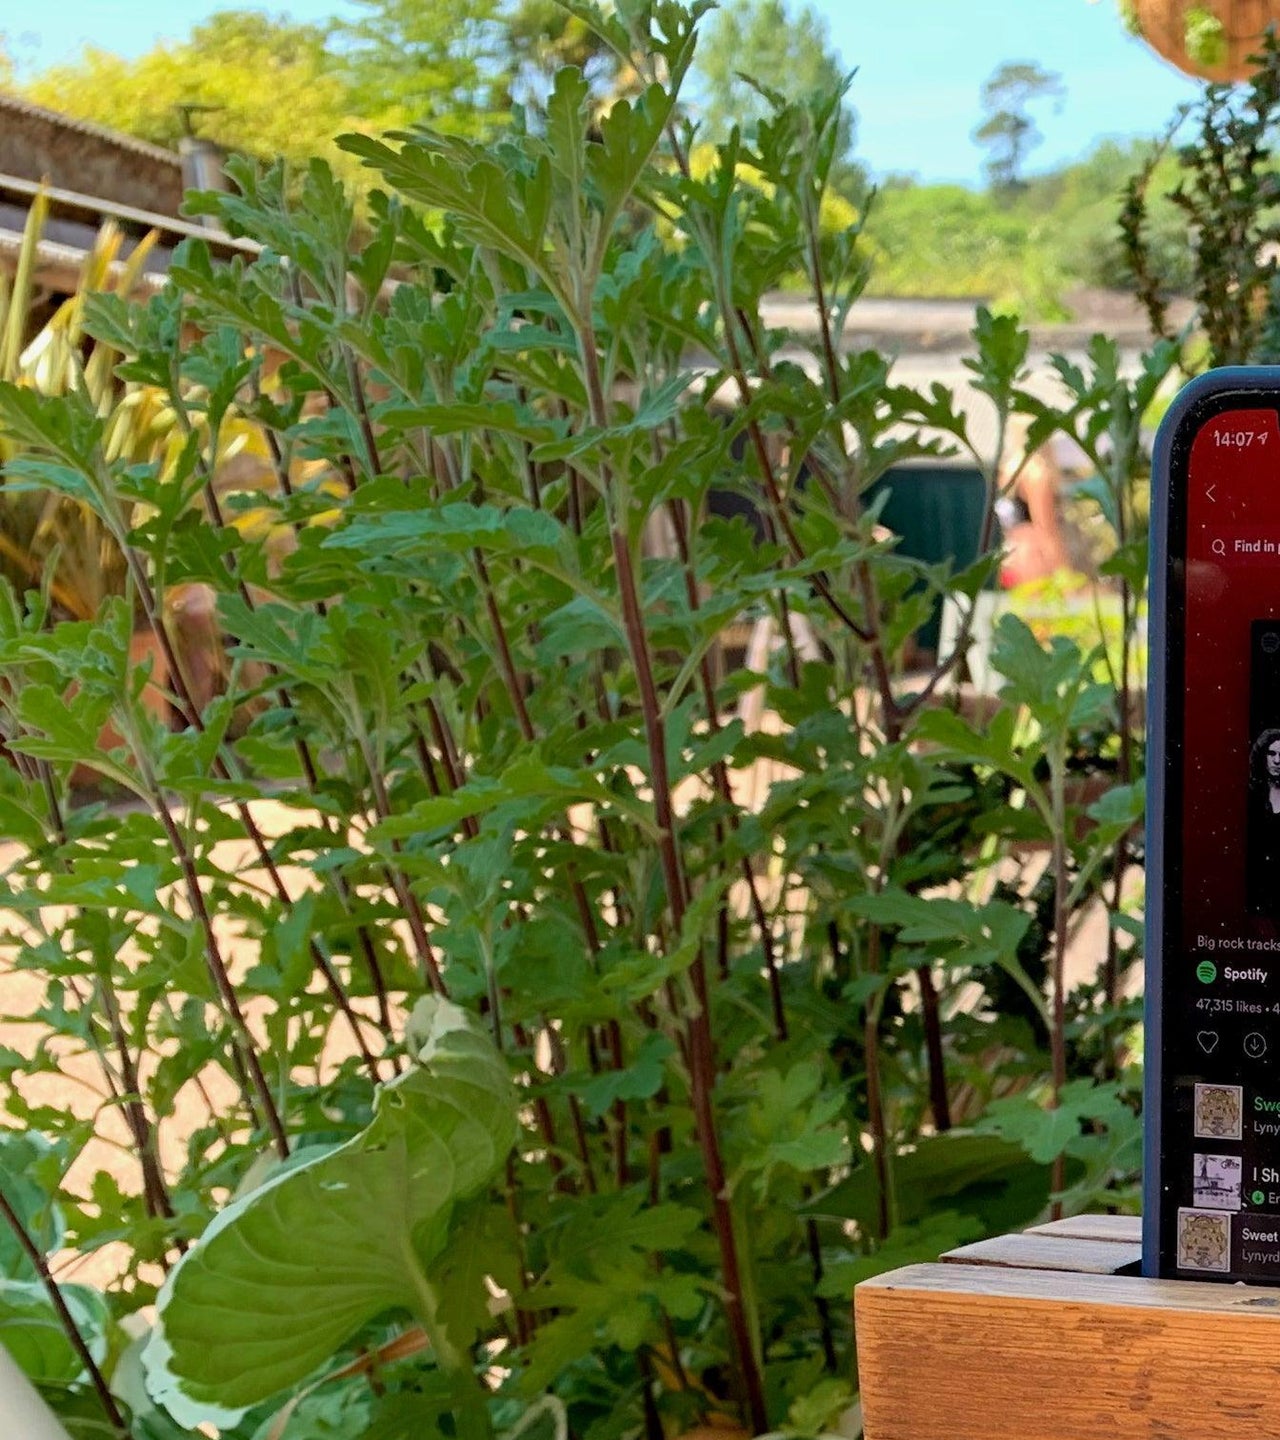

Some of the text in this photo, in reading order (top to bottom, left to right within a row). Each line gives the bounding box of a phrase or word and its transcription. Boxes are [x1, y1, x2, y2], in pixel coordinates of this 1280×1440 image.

[1213, 430, 1254, 447] 14:07
[1234, 539, 1262, 553] Find
[1264, 540, 1275, 553] in
[1197, 935, 1216, 950] Big
[1218, 937, 1245, 950] rock
[1223, 966, 1268, 984] Spotify
[1195, 998, 1233, 1013] 47,315
[1236, 1000, 1262, 1014] likes
[1241, 1228, 1278, 1243] Sweet
[1241, 1249, 1280, 1264] Lynyrd
